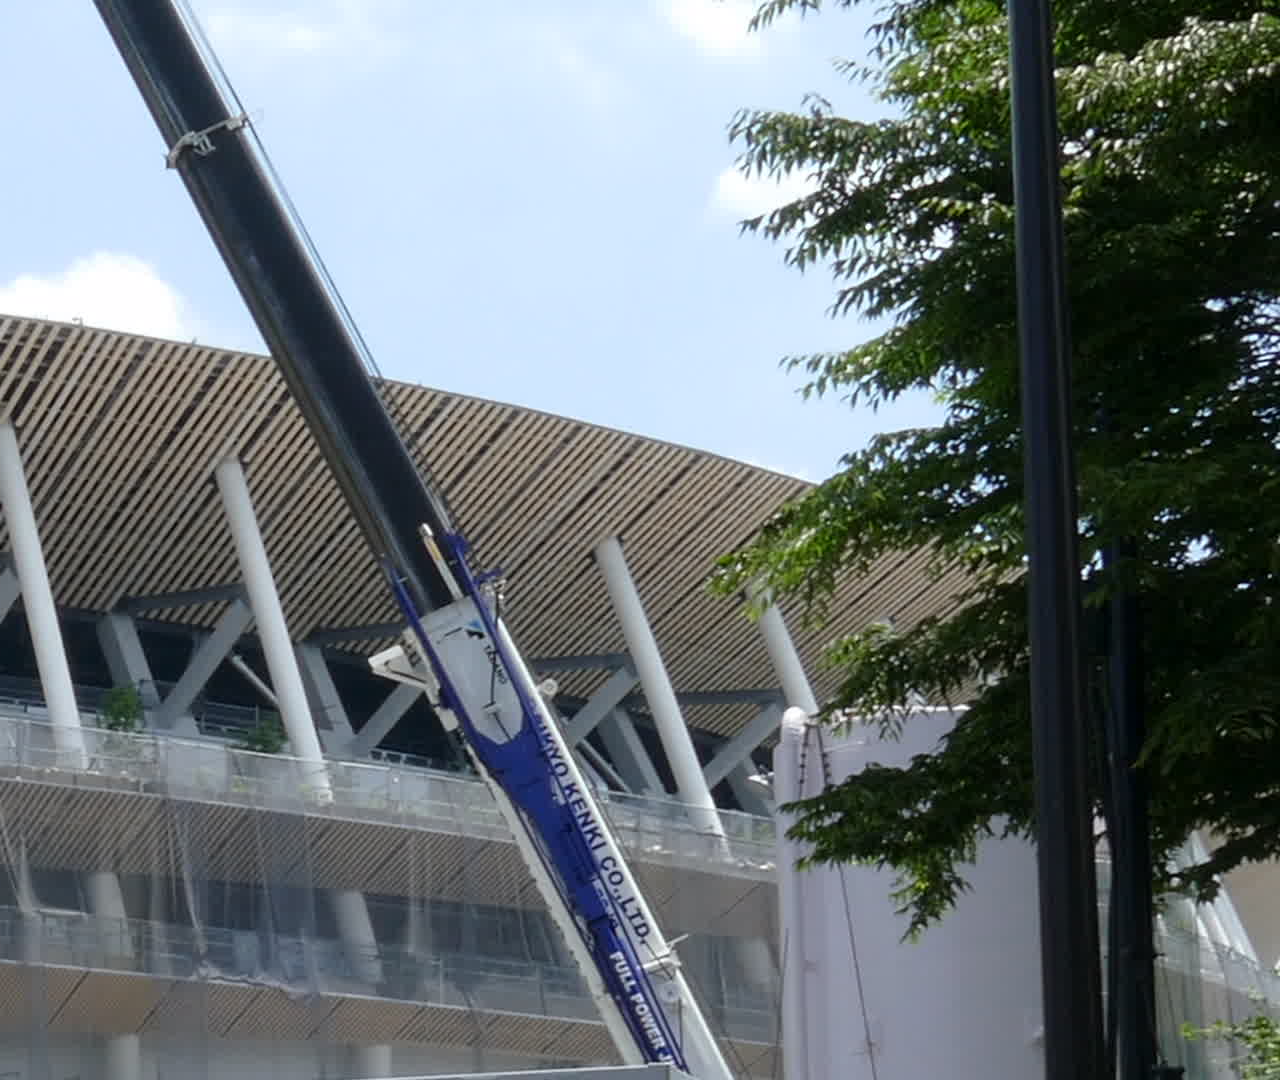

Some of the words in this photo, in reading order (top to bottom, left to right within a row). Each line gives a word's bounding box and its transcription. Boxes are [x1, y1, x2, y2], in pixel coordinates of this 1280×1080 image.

[564, 782, 608, 851] KENKI
[609, 951, 638, 993] FULL
[630, 993, 666, 1051] POWER
